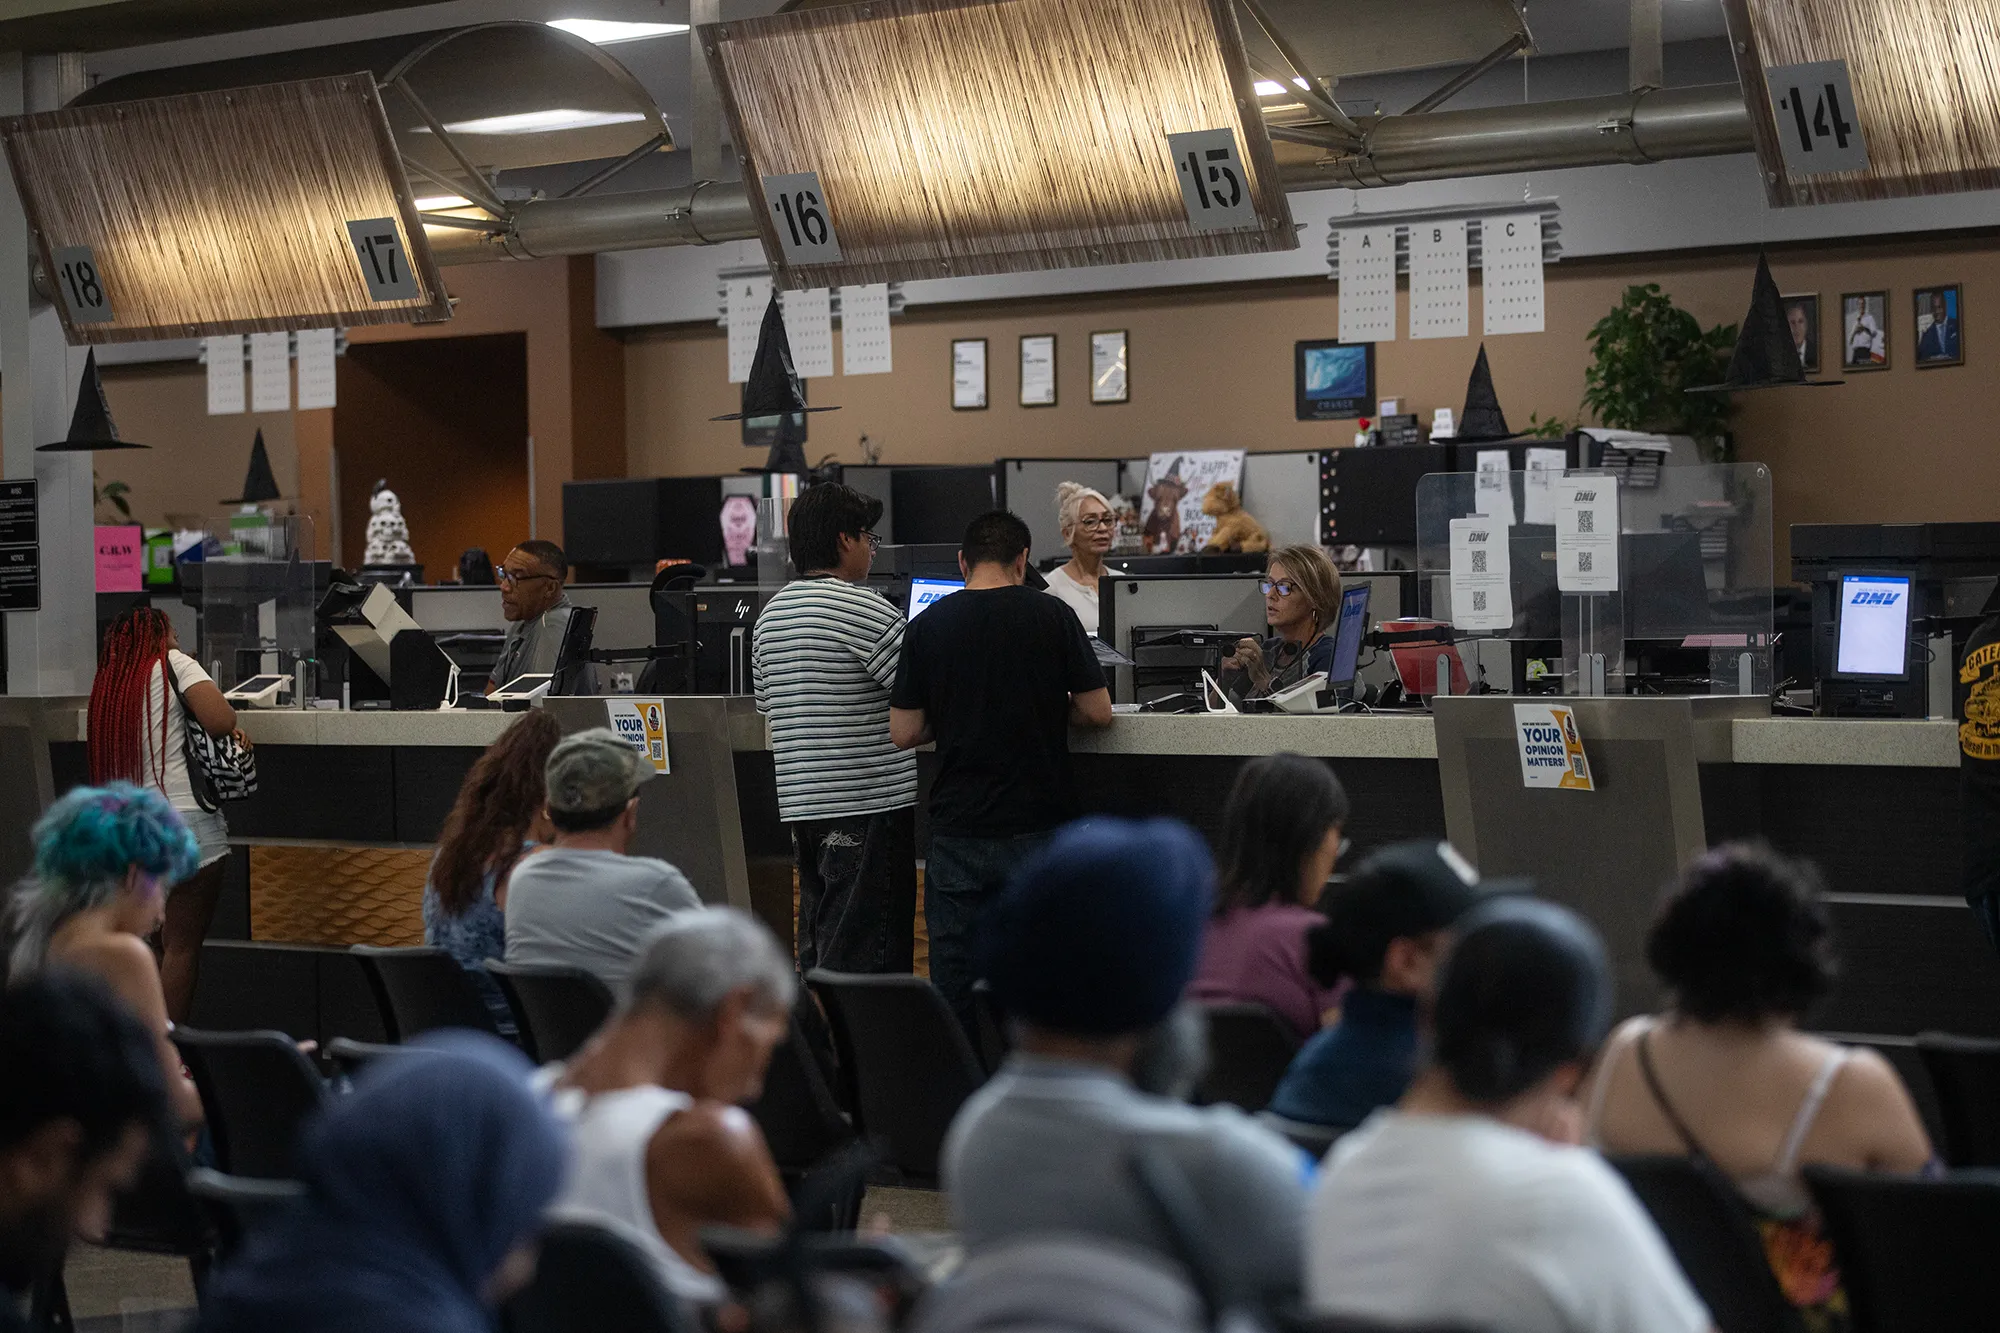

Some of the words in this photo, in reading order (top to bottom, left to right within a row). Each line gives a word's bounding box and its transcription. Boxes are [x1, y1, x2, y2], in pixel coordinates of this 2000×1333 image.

[1780, 83, 1851, 153] 14
[1181, 147, 1242, 210] 15
[774, 189, 828, 247] 16
[1433, 229, 1442, 243] B
[1505, 222, 1515, 237] C
[1362, 235, 1371, 248] A
[361, 234, 397, 284] 17
[61, 261, 103, 308] 18
[1574, 492, 1597, 502] DMV
[1468, 532, 1490, 542] DMV
[917, 592, 946, 604] DM
[1851, 591, 1901, 606] DMV
[615, 719, 643, 732] YOUR
[618, 733, 644, 742] PINION
[1523, 728, 1561, 742] YOUR
[1525, 745, 1564, 756] OPINION
[1527, 757, 1565, 767] MATTERS!
